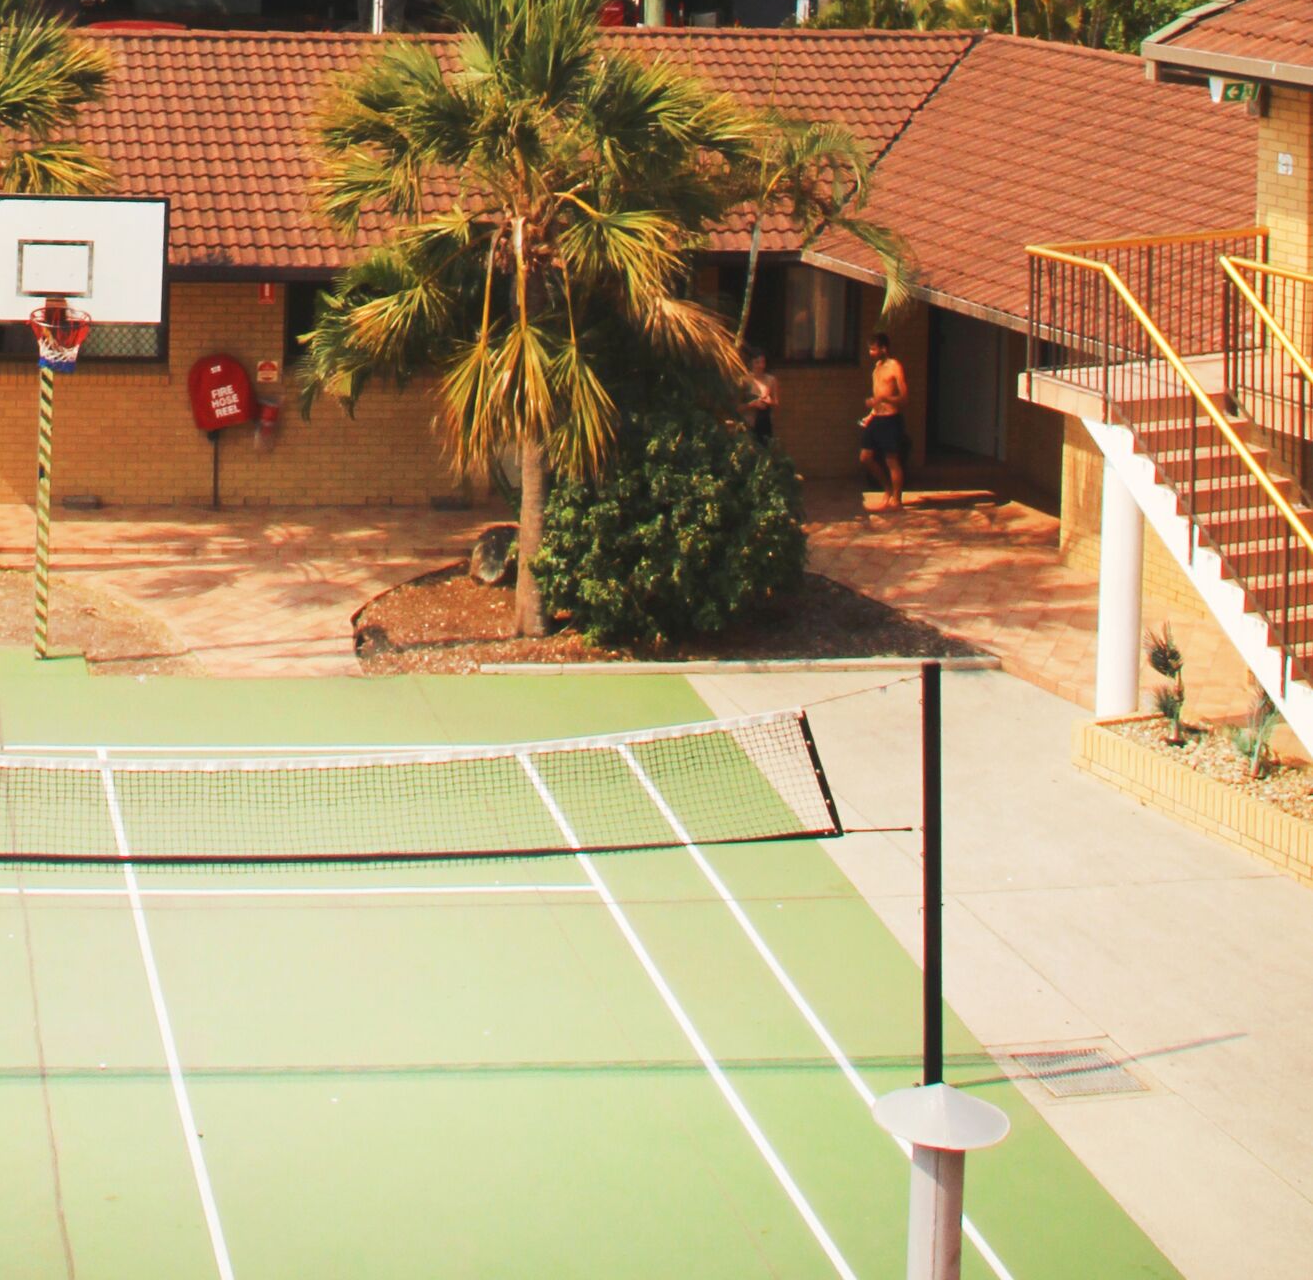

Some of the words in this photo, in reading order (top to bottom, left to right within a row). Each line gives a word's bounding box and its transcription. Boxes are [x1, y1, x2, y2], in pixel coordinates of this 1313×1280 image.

[211, 385, 234, 399] FIRE
[211, 393, 239, 408] HOSE
[215, 404, 241, 418] REEL
